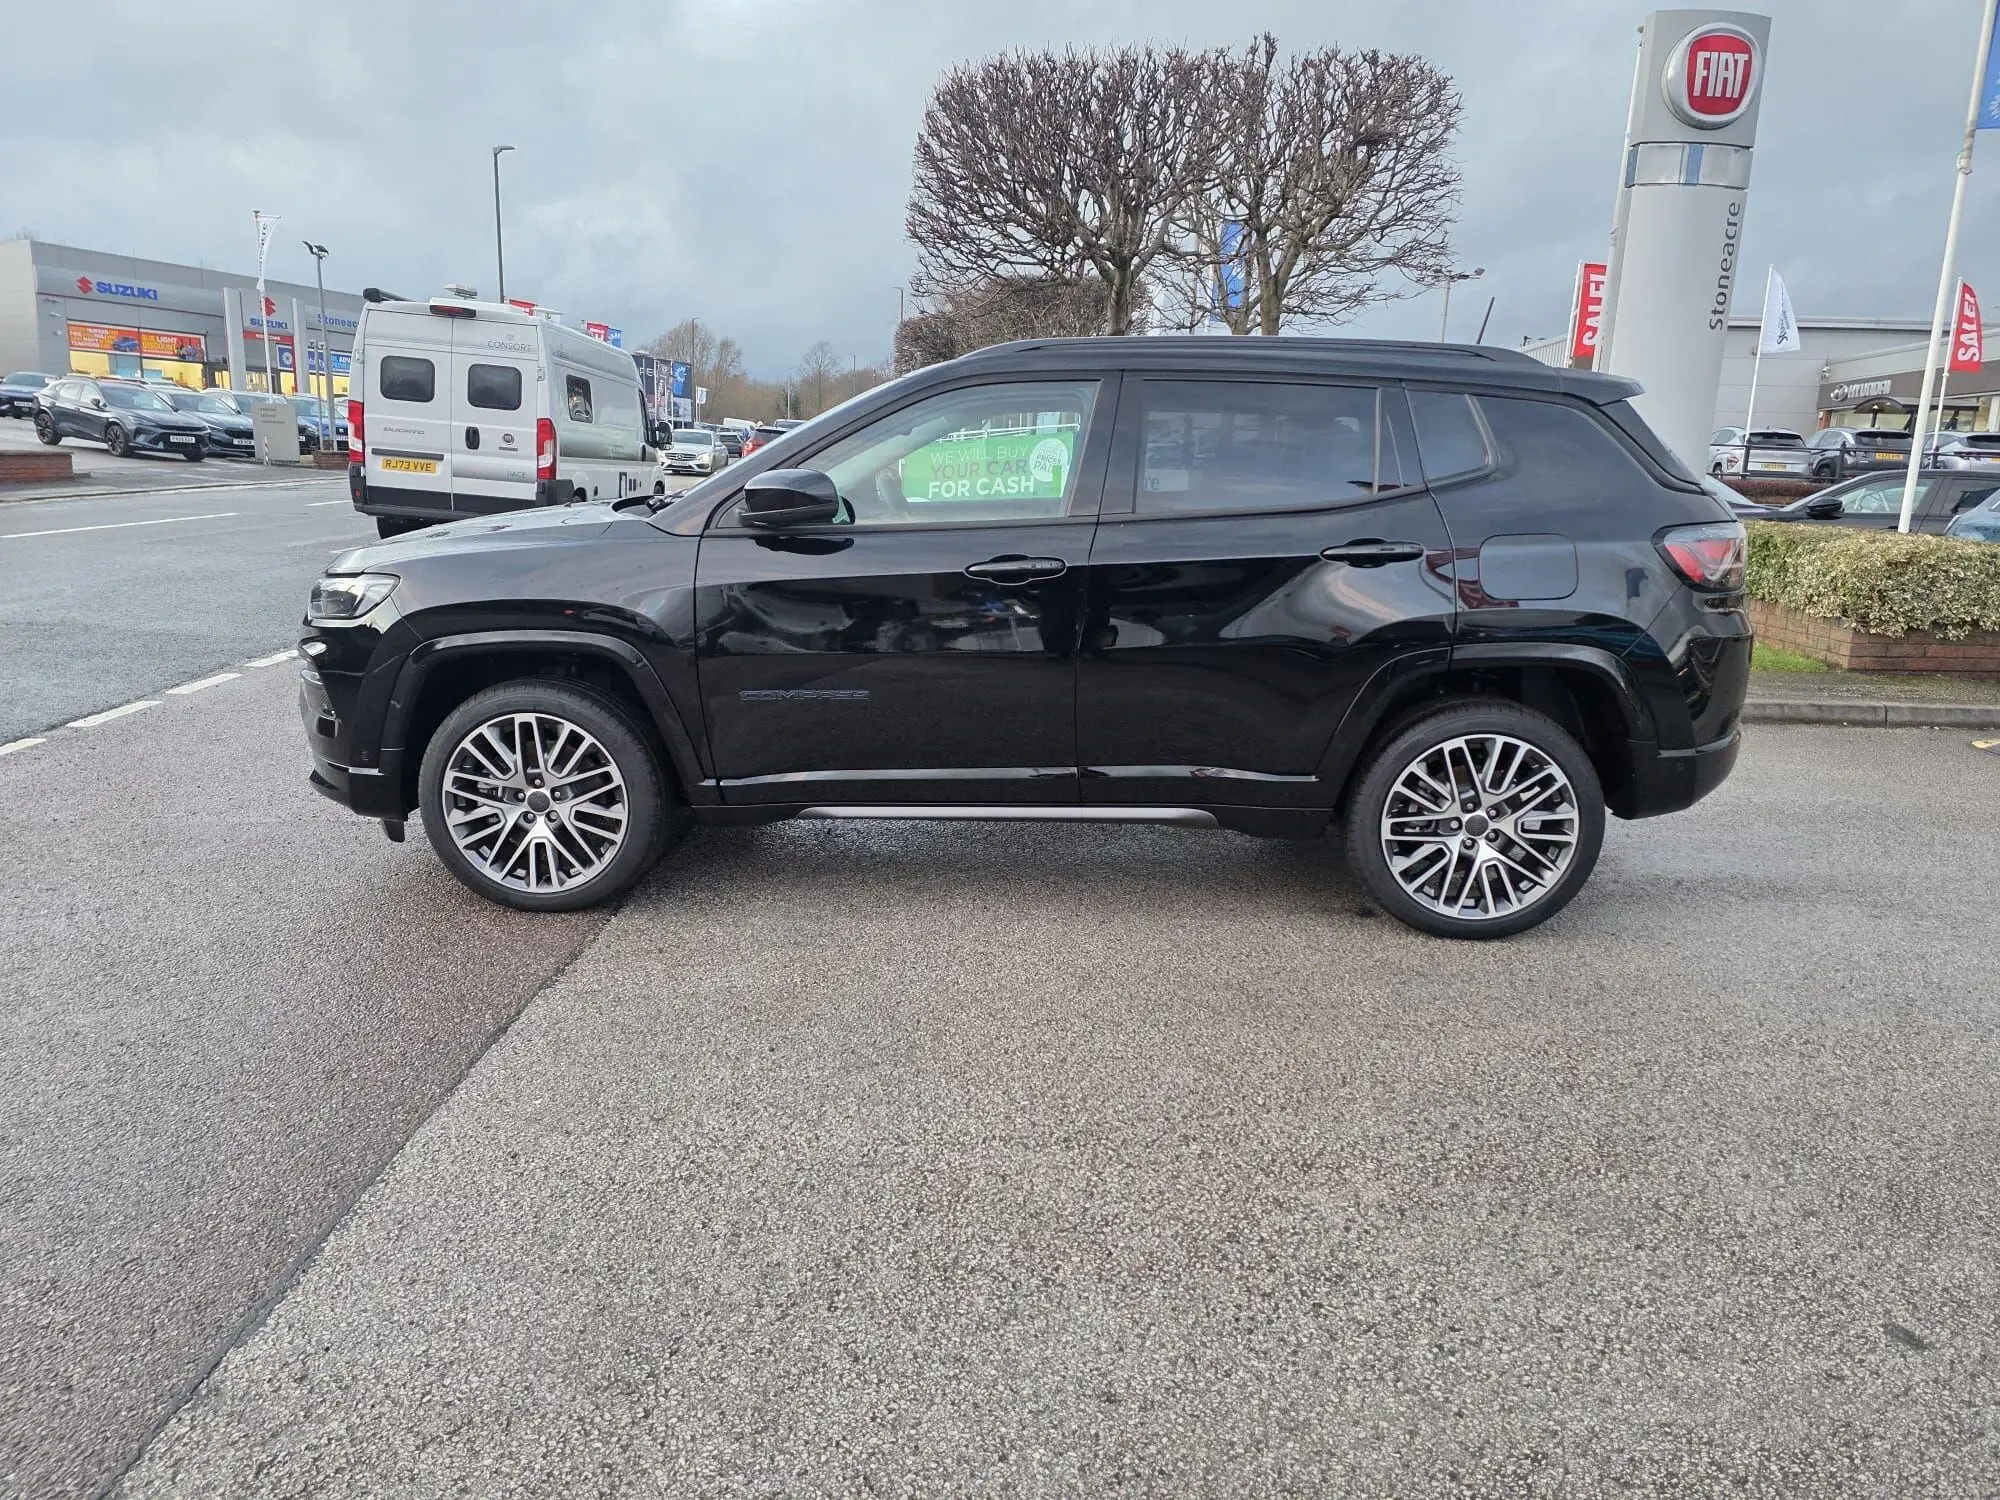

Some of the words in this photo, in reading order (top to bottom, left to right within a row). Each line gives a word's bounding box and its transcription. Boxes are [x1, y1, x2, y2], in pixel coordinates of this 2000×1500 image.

[1693, 51, 1749, 99] FIAT
[1708, 201, 1741, 331] Stoneacre
[95, 281, 158, 301] SUZUKI
[249, 316, 288, 330] SUZUKI
[316, 313, 358, 328] Stoneac
[487, 340, 533, 351] CONSORT
[1848, 380, 1891, 398] HYUNDAI
[383, 426, 425, 435] DUCATO
[931, 450, 953, 465] WE
[957, 447, 992, 463] WILL
[997, 443, 1029, 460] BUY
[385, 459, 410, 470] RJ73
[413, 461, 433, 472] VVE
[930, 462, 980, 481] YOUR
[986, 459, 1028, 476] CAR
[928, 481, 970, 499] FOR
[976, 475, 1034, 496] CASH
[739, 690, 869, 701] COMPASS
